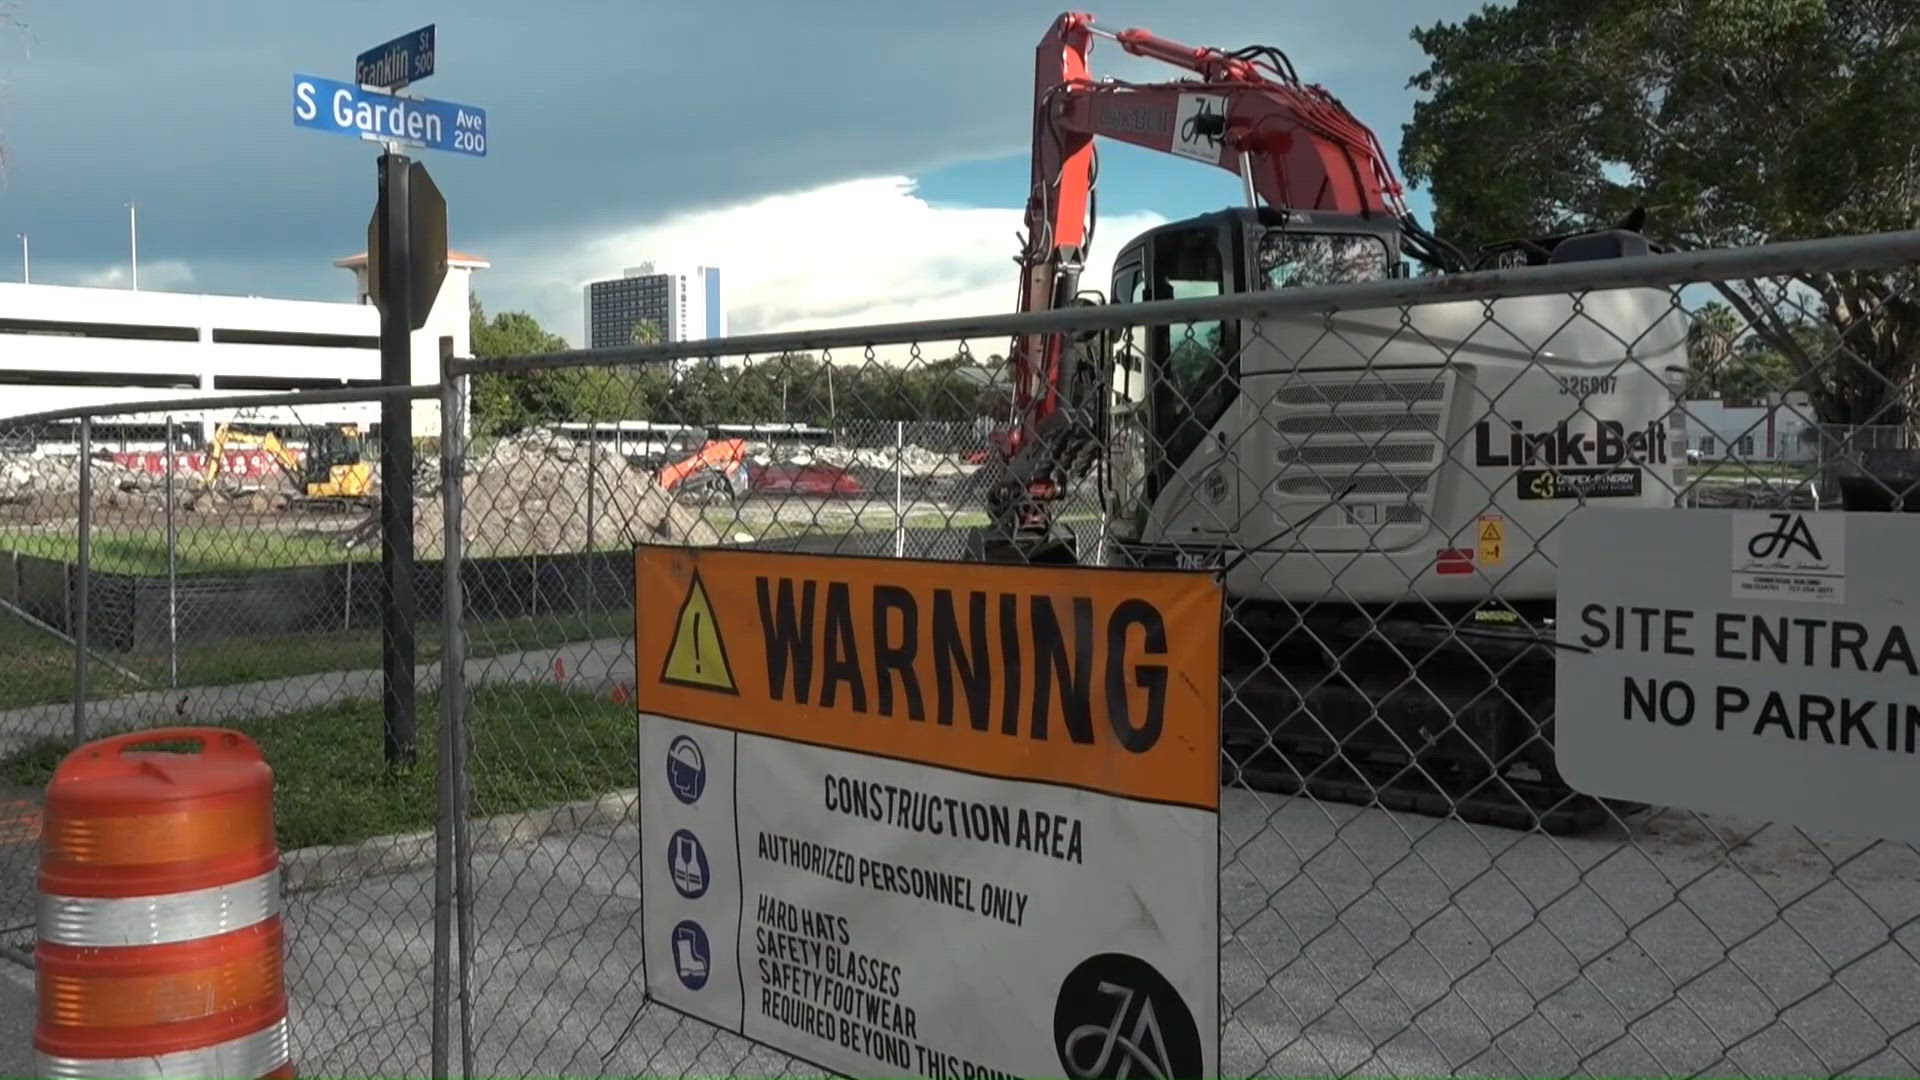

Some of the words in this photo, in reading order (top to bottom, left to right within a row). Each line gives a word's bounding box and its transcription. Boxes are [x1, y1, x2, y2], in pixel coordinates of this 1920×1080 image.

[357, 45, 409, 85] Franklin
[419, 32, 429, 51] St
[415, 51, 433, 76] 500
[296, 82, 316, 120] S
[333, 89, 441, 142] Garden
[456, 109, 482, 130] Ave
[454, 130, 485, 152] 200
[1476, 420, 1667, 467] Link-Belt
[755, 576, 1168, 753] WARNING
[1580, 603, 1695, 656] SITE
[1715, 613, 1920, 676] ENTRA
[1623, 676, 1696, 727] NO
[825, 774, 1010, 846] CONSTRUCTION
[1015, 808, 1083, 864] AREA
[758, 831, 854, 885] AUTHORIZED
[859, 857, 975, 912] PERSONNEL
[981, 883, 1028, 927] ONLY
[757, 894, 798, 933] HARD
[802, 908, 850, 945] HATS
[756, 929, 821, 969] SAFETY
[826, 953, 901, 998] GLASSES
[758, 958, 823, 1003] SAFETY
[824, 975, 916, 1039] FOOTWEAR
[762, 987, 836, 1042] REQUIRED
[840, 1016, 911, 1070] BEYOND
[915, 1044, 960, 1079] THIS
